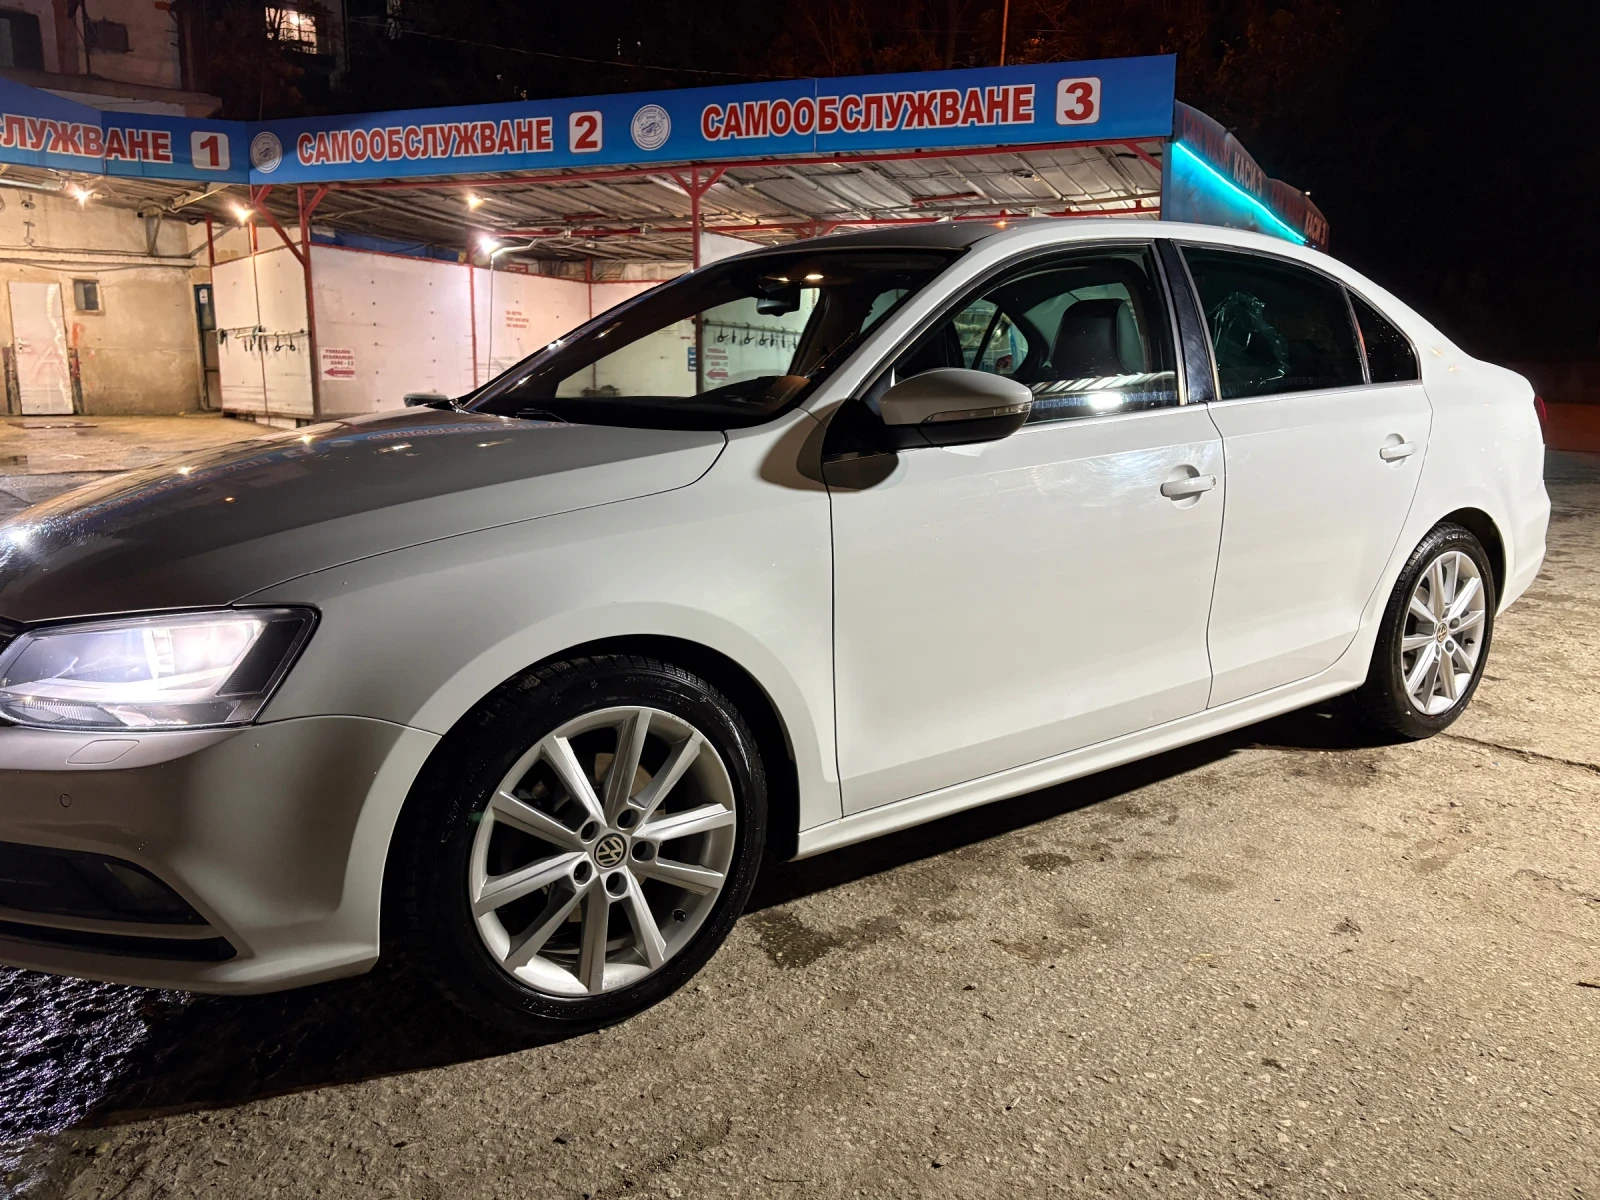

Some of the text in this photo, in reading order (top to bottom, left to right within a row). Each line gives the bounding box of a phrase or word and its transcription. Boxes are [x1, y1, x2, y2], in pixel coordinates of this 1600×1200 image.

[701, 81, 1094, 141] САМООБСЛУЖВАНЕ 3
[199, 135, 221, 167] 1
[296, 116, 553, 166] САМООБСЛУЖВАНЕ
[575, 114, 598, 150] 2
[1233, 151, 1256, 194] КАСИ
